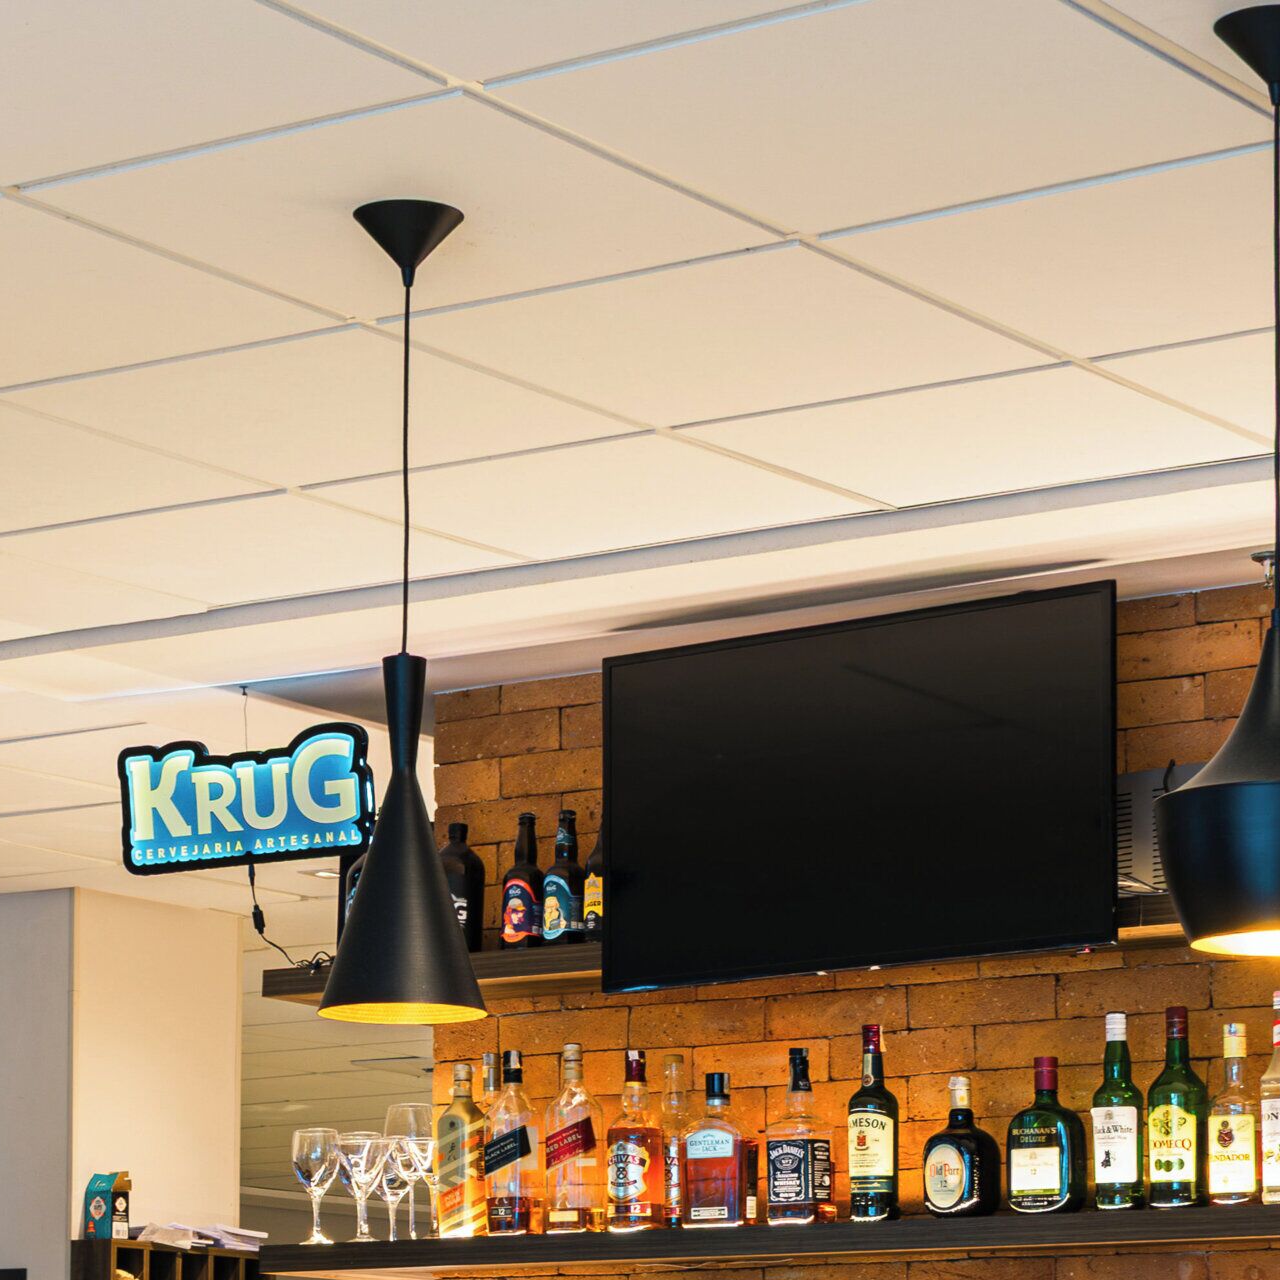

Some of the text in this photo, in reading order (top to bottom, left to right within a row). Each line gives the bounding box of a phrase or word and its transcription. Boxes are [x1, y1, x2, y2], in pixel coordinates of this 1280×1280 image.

[130, 739, 358, 841] KRUG
[134, 829, 359, 861] CERVEJARIA ARTESANAL
[851, 1117, 887, 1131] MESON
[689, 1139, 730, 1147] GENTLEMAN
[608, 1154, 640, 1165] CHIVAS
[1214, 1153, 1251, 1162] NDADOR
[498, 1208, 506, 1216] 12
[630, 1204, 641, 1213] 12
